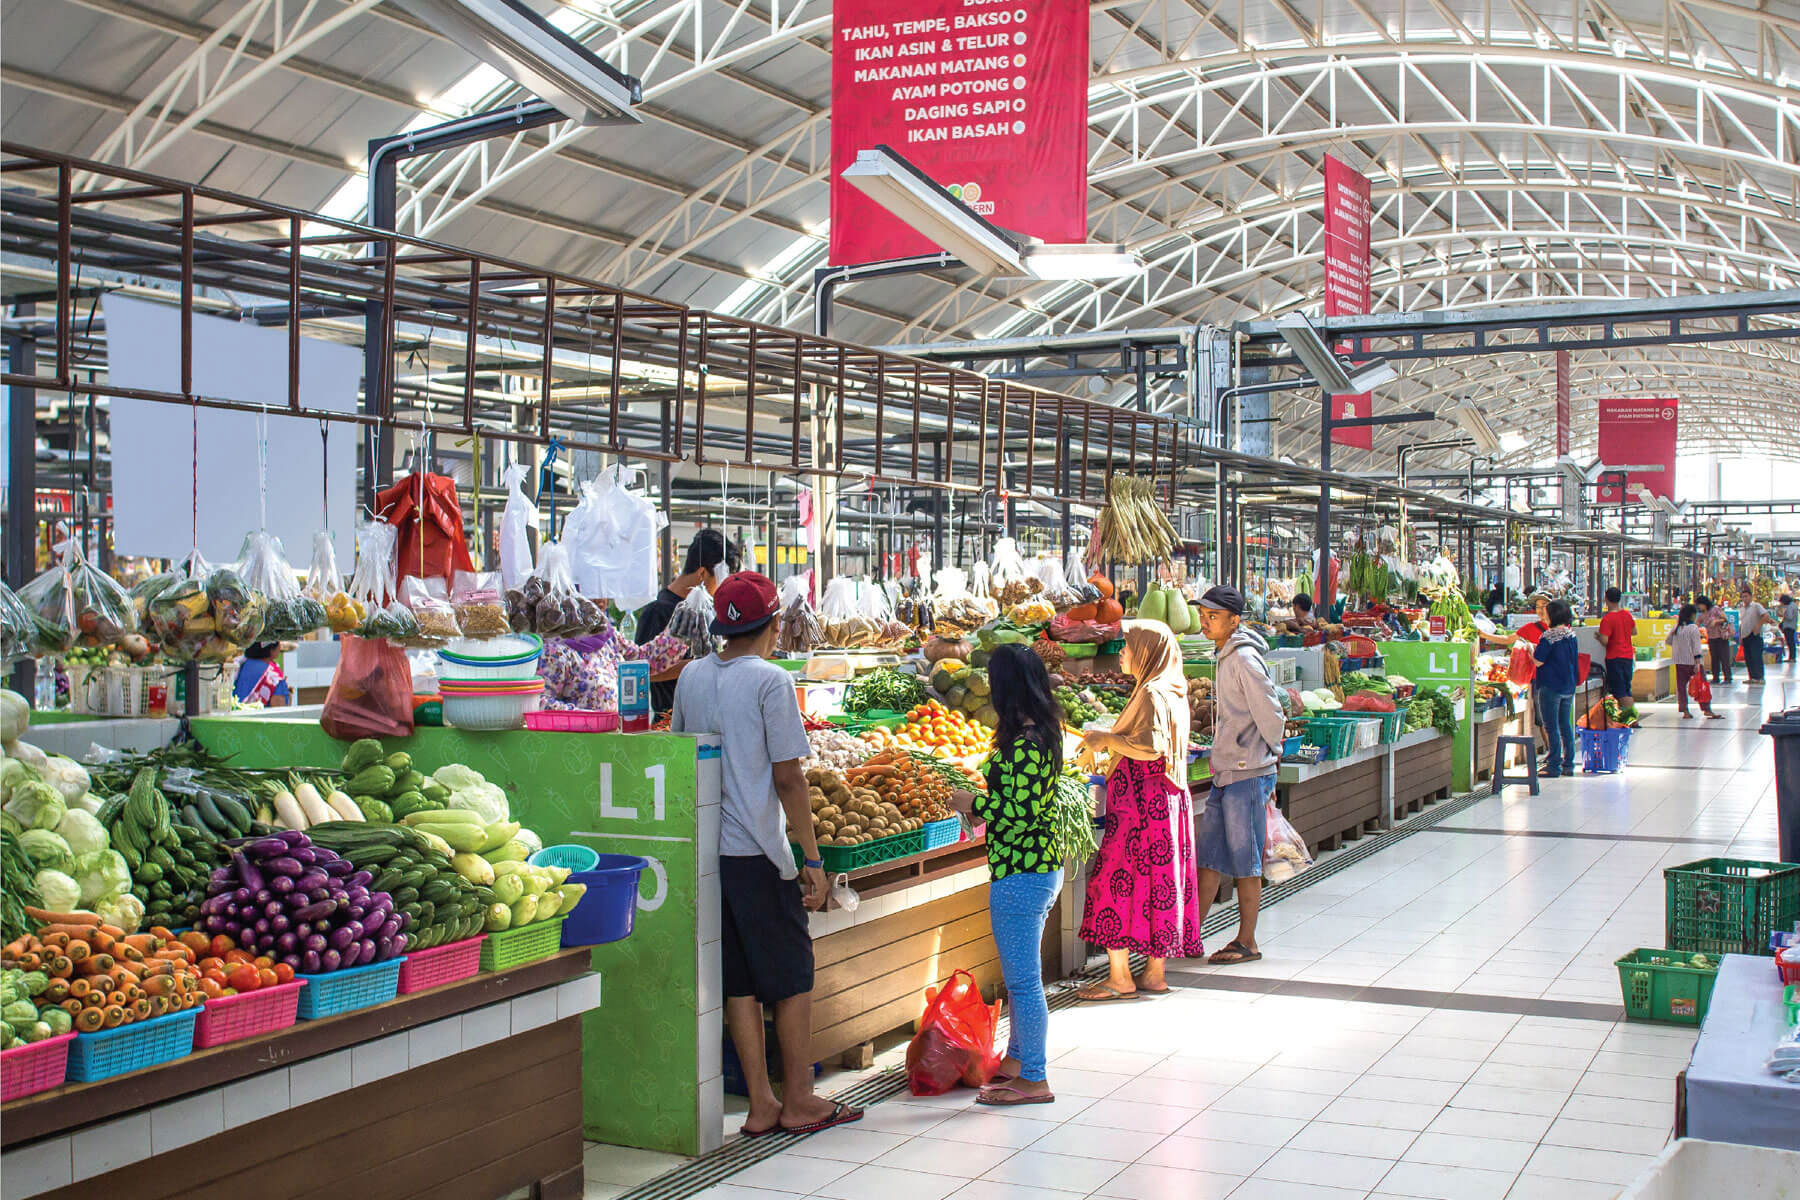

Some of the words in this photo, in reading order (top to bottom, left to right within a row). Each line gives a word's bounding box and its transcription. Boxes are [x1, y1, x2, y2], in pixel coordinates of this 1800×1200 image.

[842, 24, 889, 42] TAHU,
[893, 17, 950, 36] TEMPE,
[954, 11, 1011, 29] BAKSO
[855, 45, 893, 61] IKAN
[898, 41, 936, 57] ASIN
[941, 39, 953, 52] &
[956, 33, 1009, 51] TELUR
[854, 61, 937, 82] MAKANAN
[940, 56, 1009, 74] MATANG
[892, 83, 937, 101] AYAM
[940, 78, 1009, 96] POTONG
[904, 102, 969, 121] DAGING
[972, 100, 1010, 116] SAPI
[908, 126, 948, 143] IKAN
[951, 122, 1009, 139] BASAH
[1429, 652, 1458, 673] L1
[600, 762, 665, 821] L1
